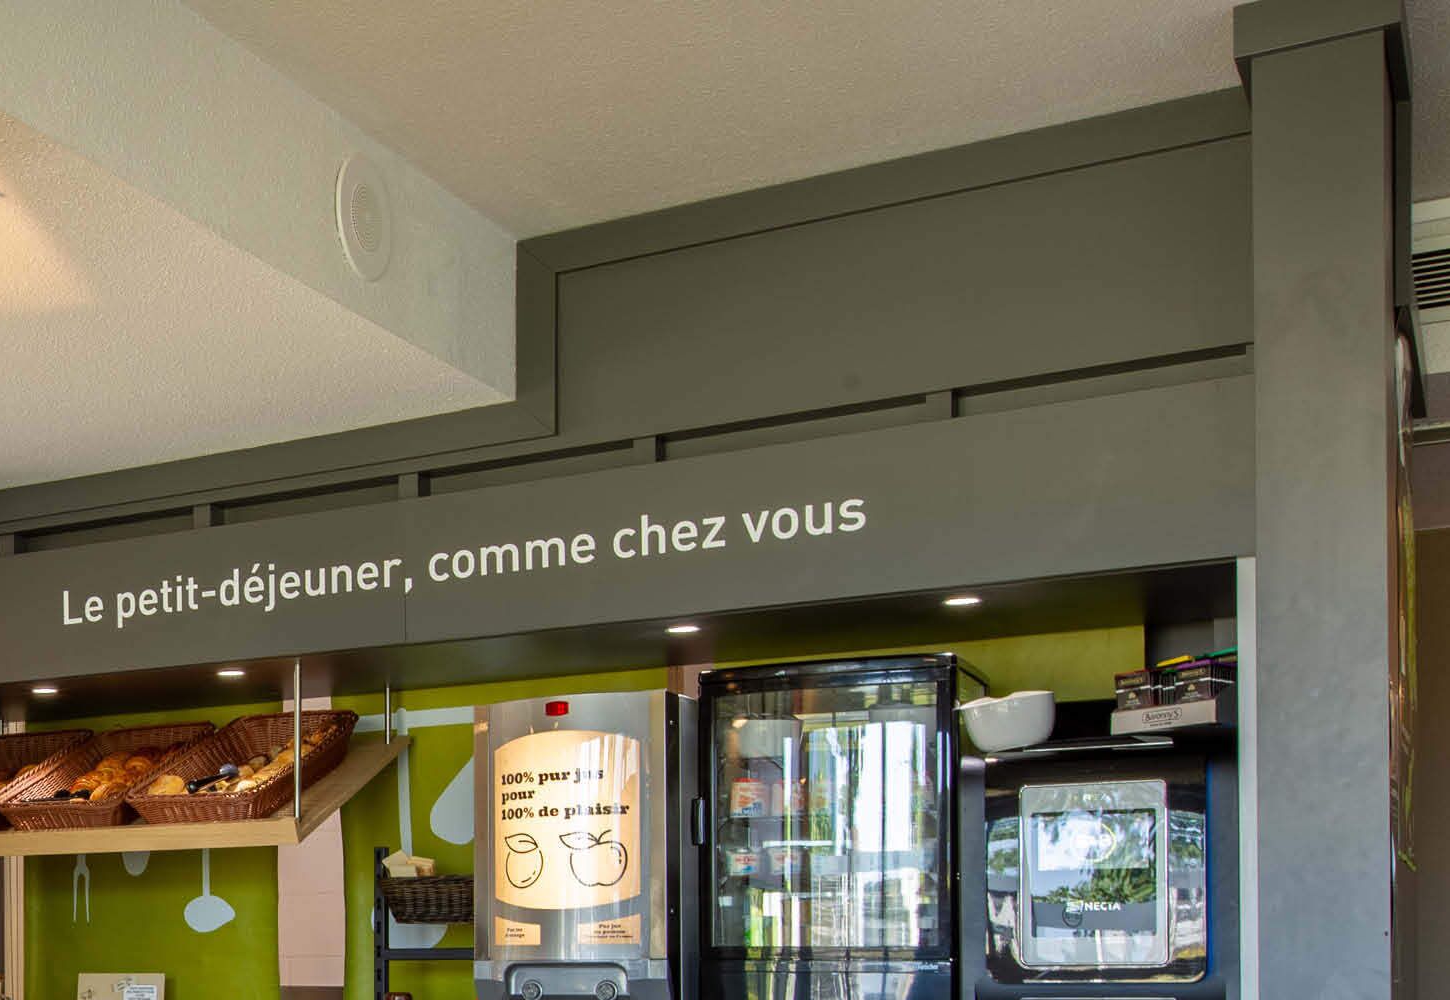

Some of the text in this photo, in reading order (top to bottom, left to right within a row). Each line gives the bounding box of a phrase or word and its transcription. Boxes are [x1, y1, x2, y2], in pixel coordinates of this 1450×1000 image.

[64, 498, 867, 629] Le petit-déjeuner, comme chez vous
[502, 772, 534, 785] 100%
[538, 771, 570, 785] pur
[502, 790, 535, 805] pour
[502, 807, 534, 821] 100%
[538, 806, 559, 817] de
[1085, 901, 1121, 912] NECTA
